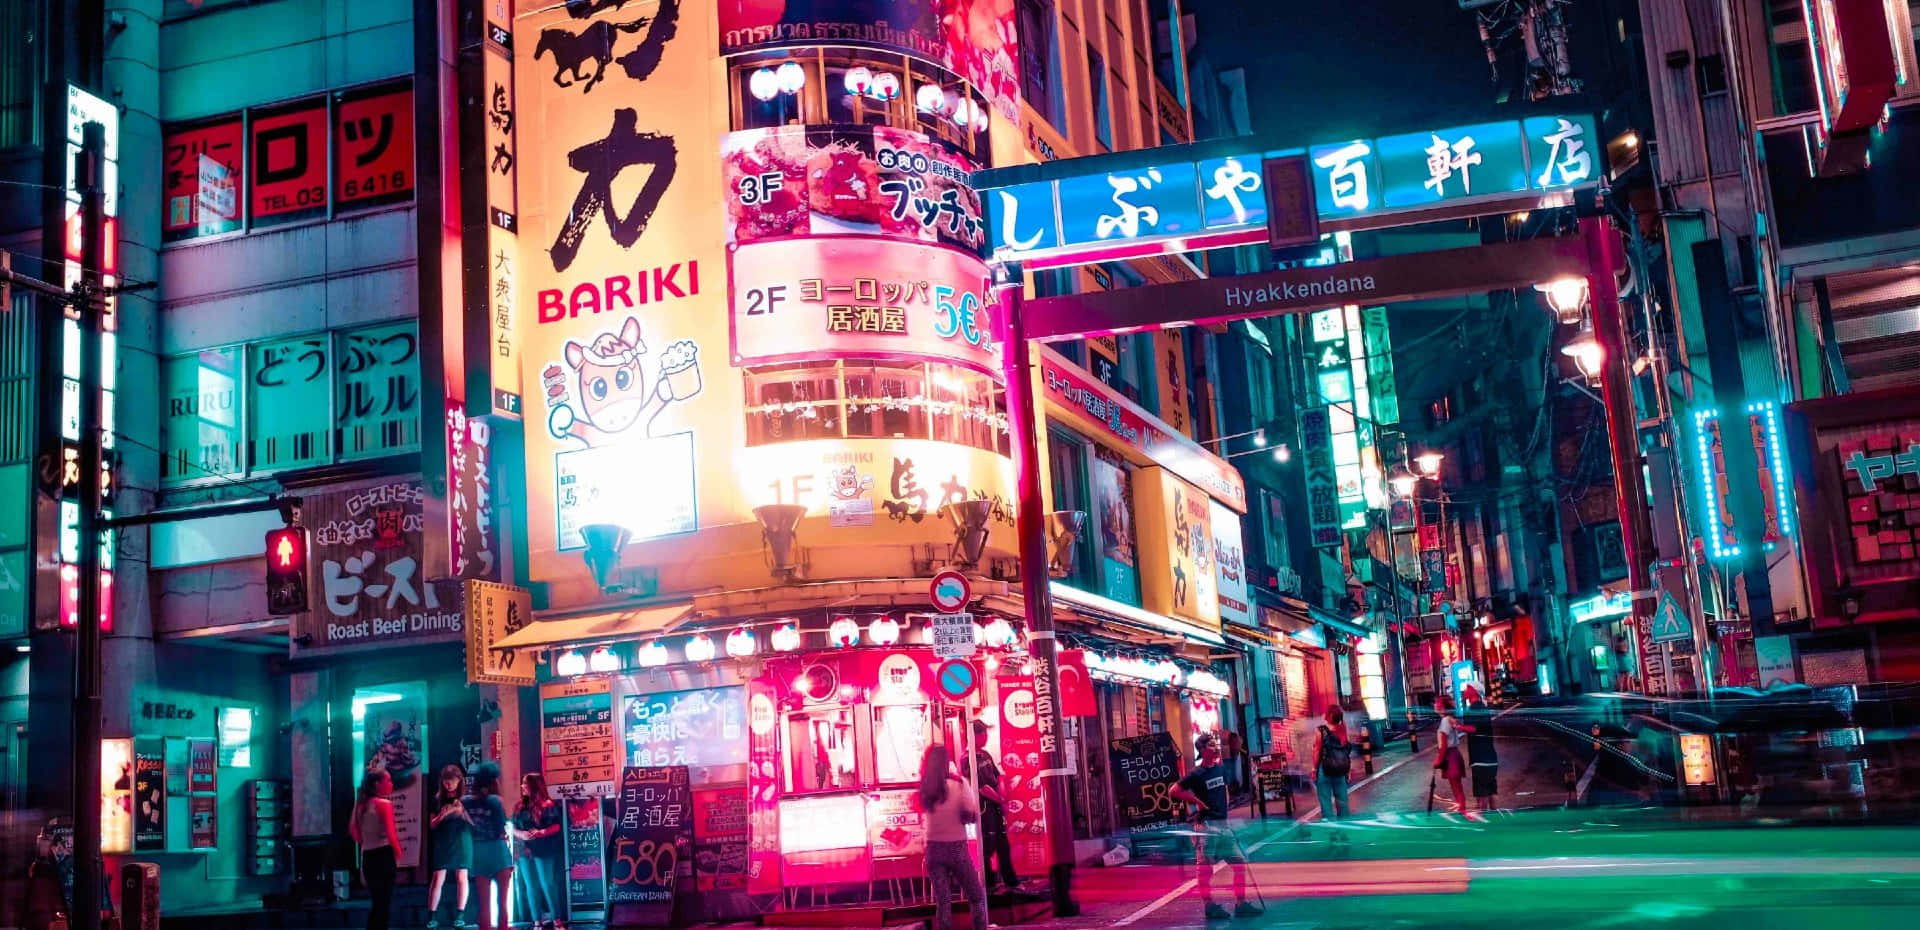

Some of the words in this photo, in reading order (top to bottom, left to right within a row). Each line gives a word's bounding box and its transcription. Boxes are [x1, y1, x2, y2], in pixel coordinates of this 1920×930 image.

[492, 27, 508, 43] 2F
[488, 80, 513, 176] 馬力
[879, 150, 927, 173] お肉の
[931, 160, 972, 189] 創作居酒
[1000, 119, 1591, 250] しぶや百軒店
[296, 187, 324, 205] 03
[345, 171, 406, 198] 6416
[740, 172, 783, 204] 3F
[497, 212, 513, 227] 1F
[494, 248, 511, 358] 大衆屋台
[537, 260, 699, 324] BARIKI
[799, 277, 929, 303] ヨーロッパ
[1225, 275, 1376, 307] Hyakkendana
[746, 285, 787, 316] 2F
[934, 285, 981, 347] 5€
[826, 304, 907, 335] 居酒屋
[256, 332, 417, 387] どうぶつ
[1100, 359, 1112, 385] 3F
[169, 390, 234, 417] RURU
[340, 374, 419, 422] ルル
[502, 396, 516, 411] 1F
[470, 419, 495, 577] ローストビーフ
[768, 474, 815, 506] 1F
[881, 456, 968, 524] 馬力
[316, 518, 376, 546] 油そば
[328, 619, 369, 640] Roast
[373, 614, 406, 635] Beef
[411, 611, 461, 631] Dining
[1034, 656, 1057, 753] 渋谷百軒店
[1128, 765, 1171, 784] FOOD
[621, 804, 682, 828] 居酒屋
